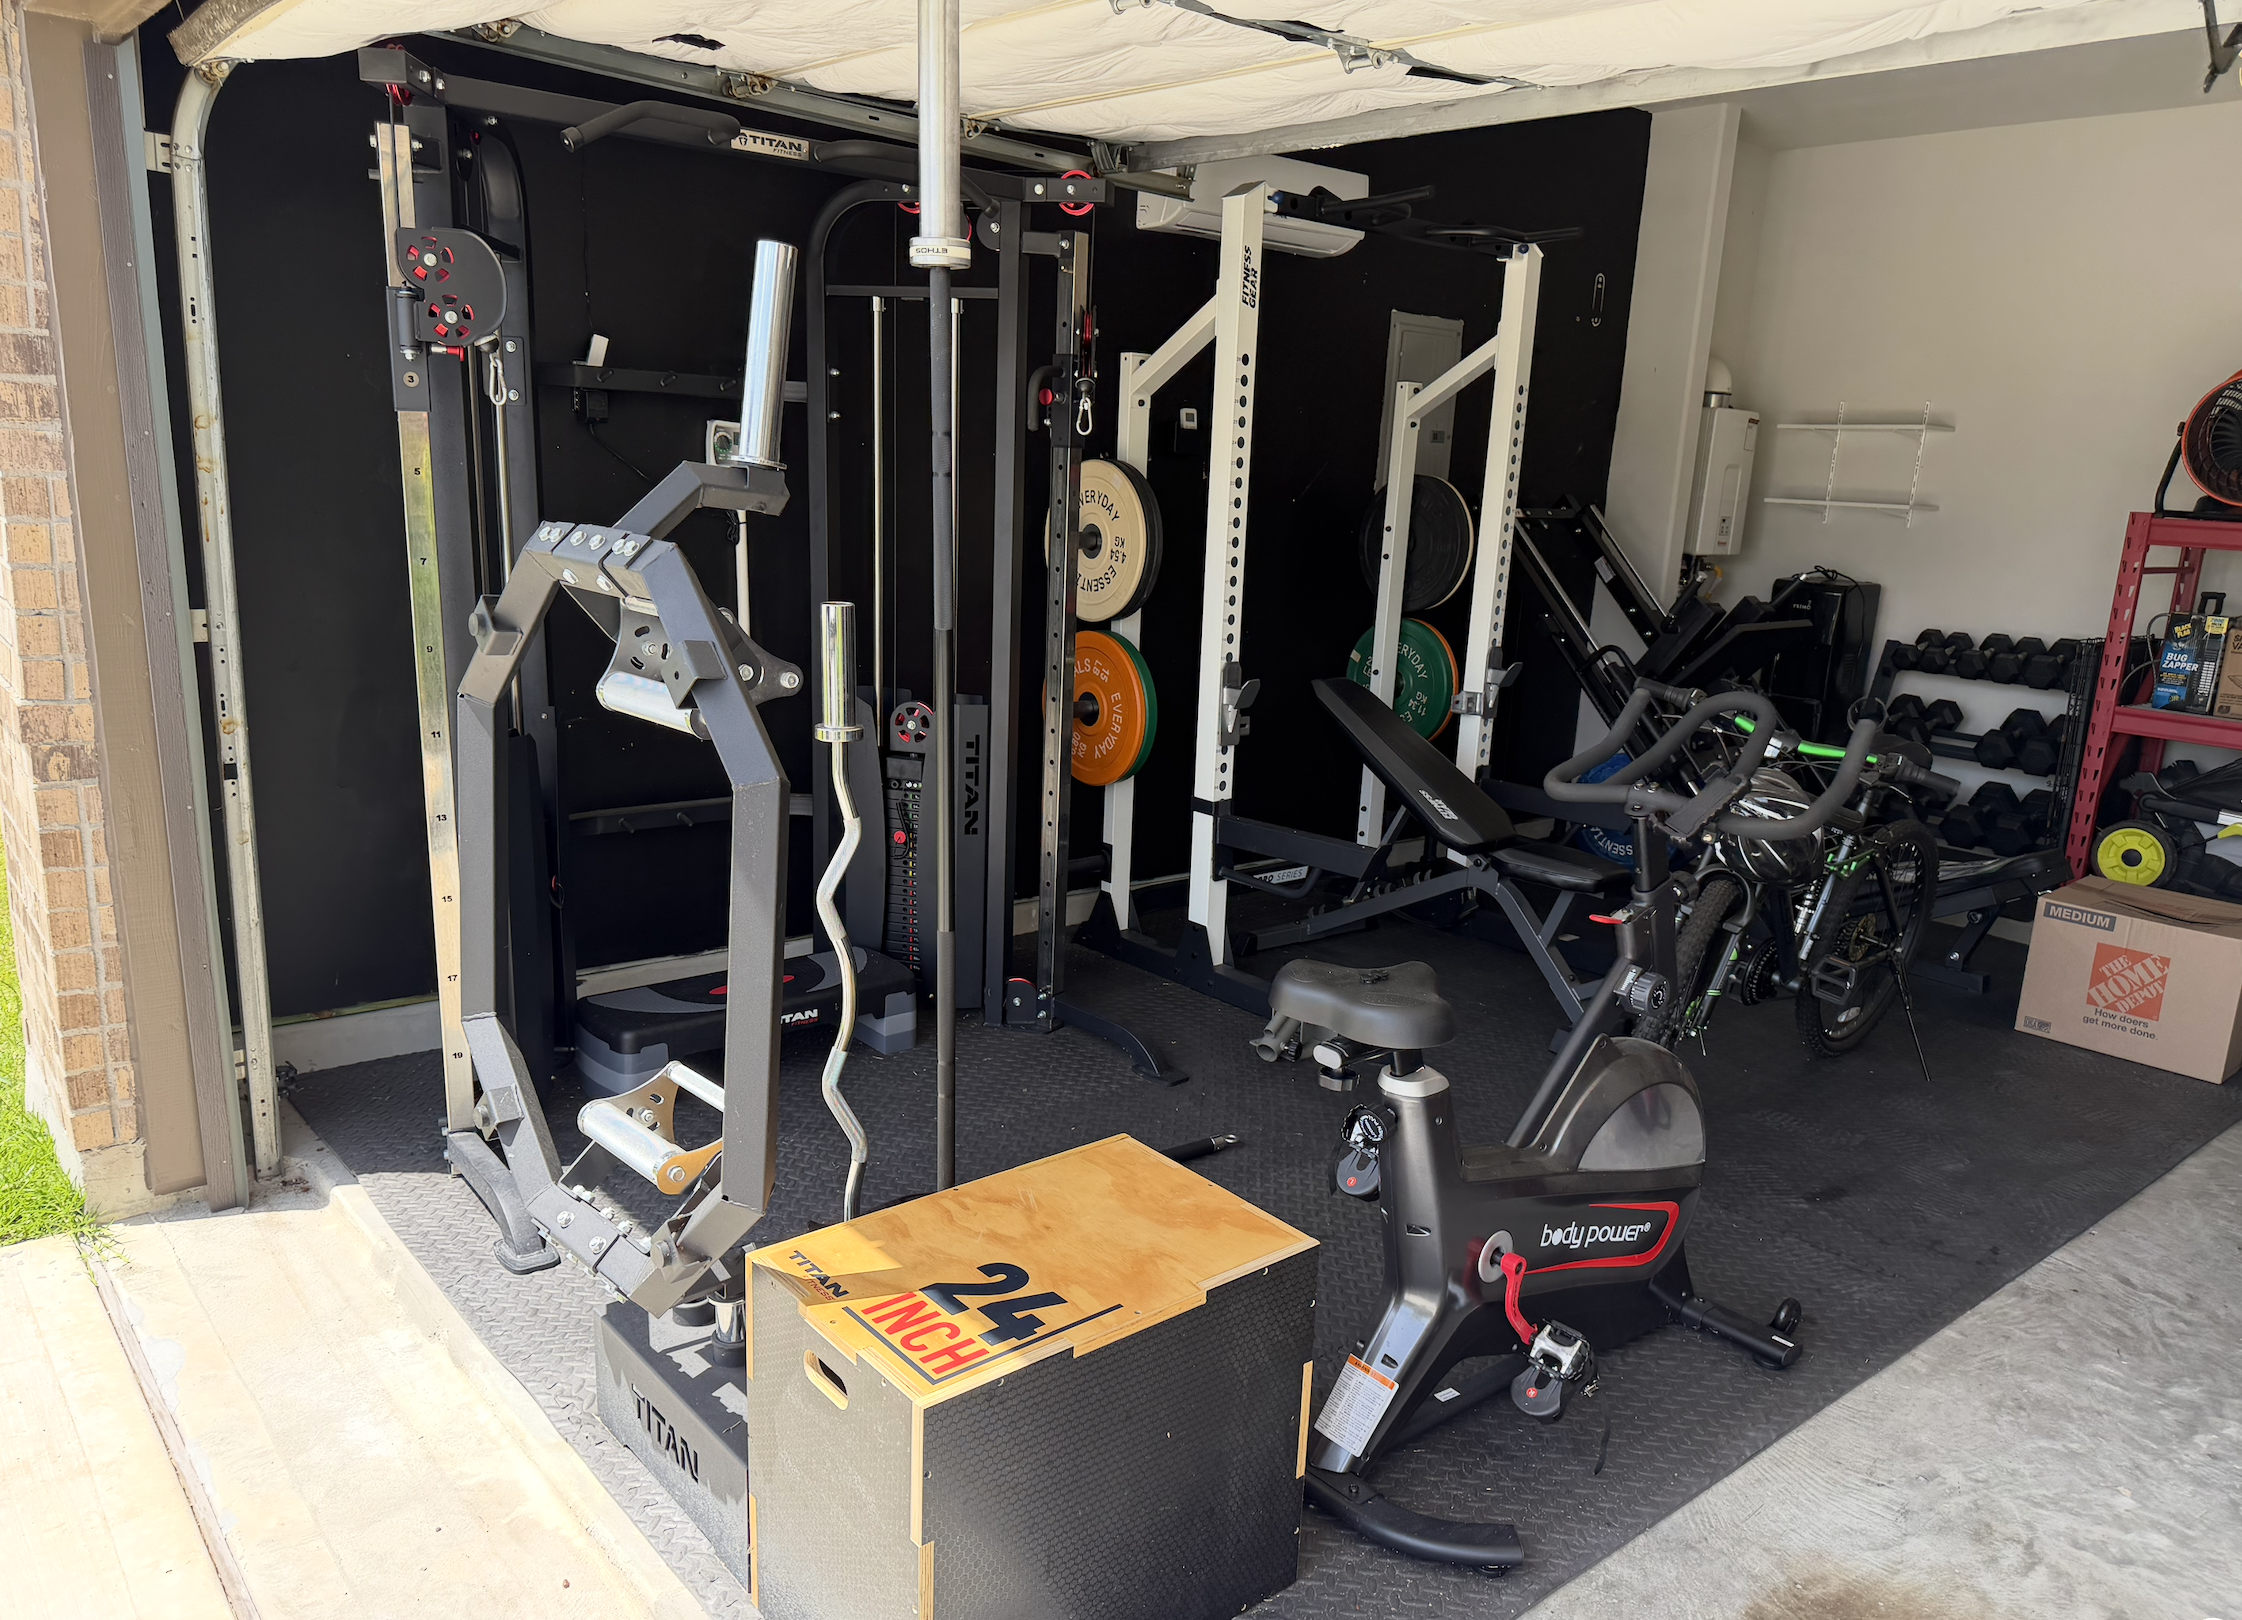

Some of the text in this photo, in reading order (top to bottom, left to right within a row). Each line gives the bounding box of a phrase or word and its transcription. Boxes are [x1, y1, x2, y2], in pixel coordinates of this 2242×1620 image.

[748, 134, 802, 152] TITAN
[773, 148, 802, 157] FITNESS
[1242, 245, 1252, 306] FITNESS
[1249, 267, 1258, 309] GEAR
[407, 375, 415, 384] 3
[414, 467, 421, 476] 5
[420, 557, 427, 566] 7
[1110, 536, 1127, 564] 4.54 KG
[2174, 623, 2192, 633] BLACK
[426, 645, 433, 653] 9
[2166, 653, 2188, 662] BUG
[1092, 660, 1103, 676] LB
[1100, 668, 1110, 683] 15
[2161, 660, 2199, 672] ZAPPER
[1408, 691, 1428, 716] 11.34 KG
[1094, 692, 1123, 759] EVERYDAY
[1077, 742, 1087, 758] KG
[964, 734, 981, 836] TITAN
[1276, 869, 1303, 881] SERIES
[2049, 905, 2110, 928] MEDIUM
[447, 974, 458, 982] 17
[2099, 955, 2132, 978] THE
[2088, 954, 2169, 1008] HOME
[2115, 980, 2164, 1013] DEPOT
[2083, 1015, 2159, 1041] get more done.
[2094, 1008, 2149, 1029] How doers
[452, 1052, 463, 1060] 19
[1540, 1221, 1585, 1249] body
[789, 1250, 850, 1298] TITAN
[802, 1274, 836, 1301] FITNESS
[919, 1262, 1069, 1346] 24
[860, 1292, 990, 1375] INCH
[631, 1383, 699, 1484] TITAN
